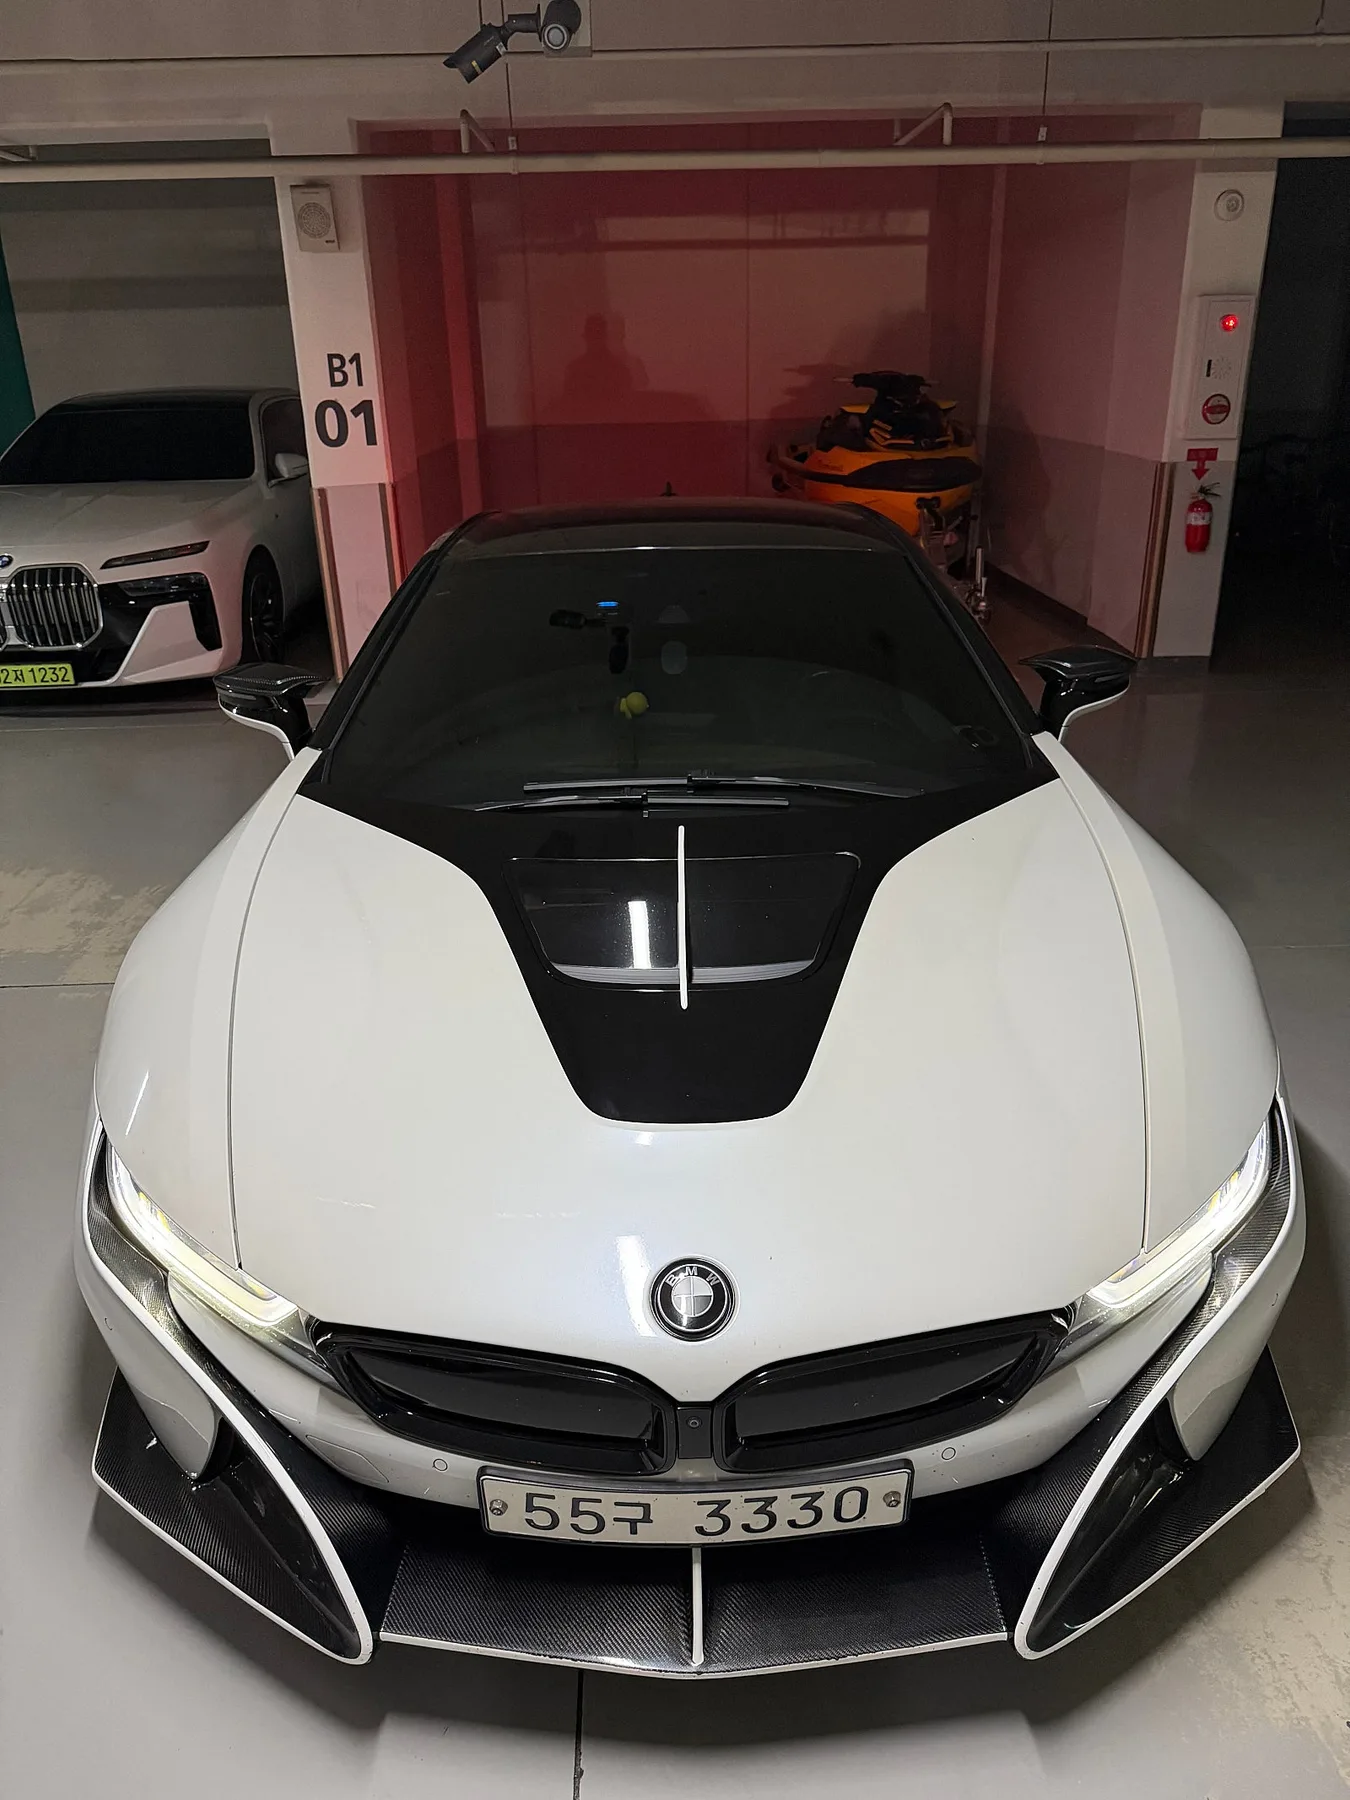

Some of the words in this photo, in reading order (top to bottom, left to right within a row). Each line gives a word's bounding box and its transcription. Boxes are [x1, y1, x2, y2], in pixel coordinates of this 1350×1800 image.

[327, 352, 364, 387] B1
[315, 399, 378, 448] 01
[0, 668, 26, 684] 2저
[28, 666, 71, 683] 1232
[664, 1266, 721, 1288] BMW
[524, 1492, 654, 1535] 55구
[694, 1486, 869, 1536] 3330
